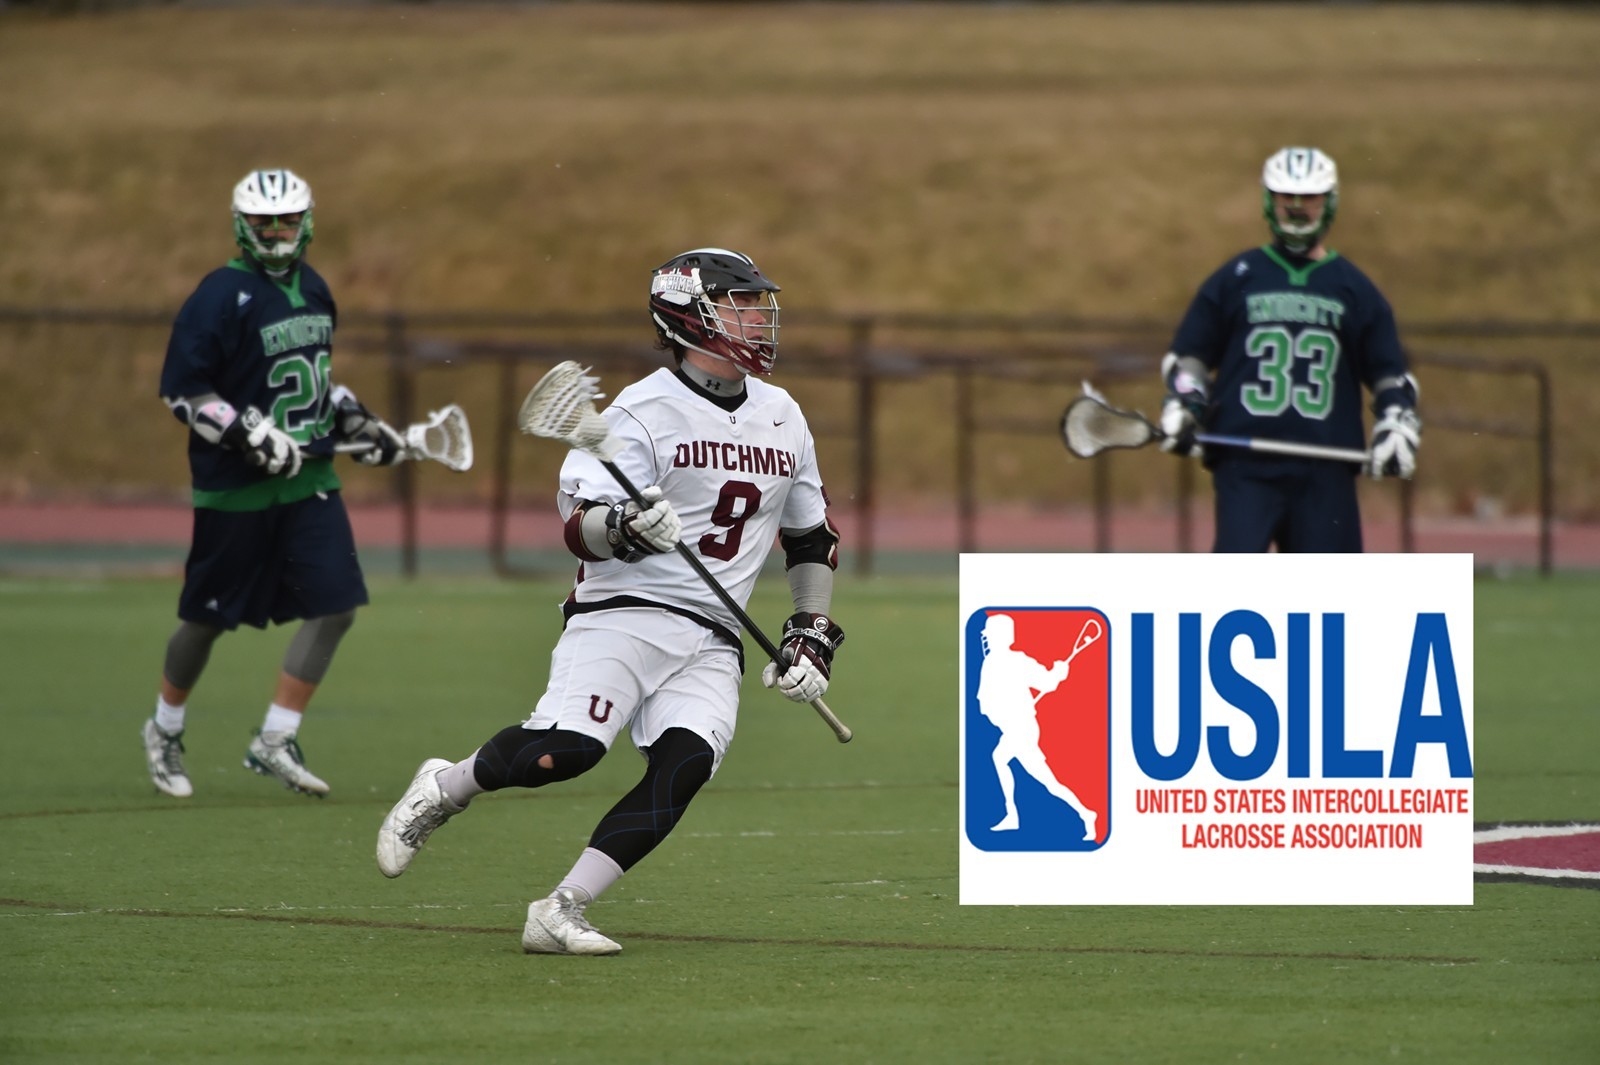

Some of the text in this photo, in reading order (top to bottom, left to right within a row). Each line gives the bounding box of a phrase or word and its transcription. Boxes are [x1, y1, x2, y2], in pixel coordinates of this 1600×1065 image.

[1241, 325, 1341, 420] 33
[729, 416, 737, 425] U
[697, 479, 763, 562] 9
[588, 694, 614, 724] U
